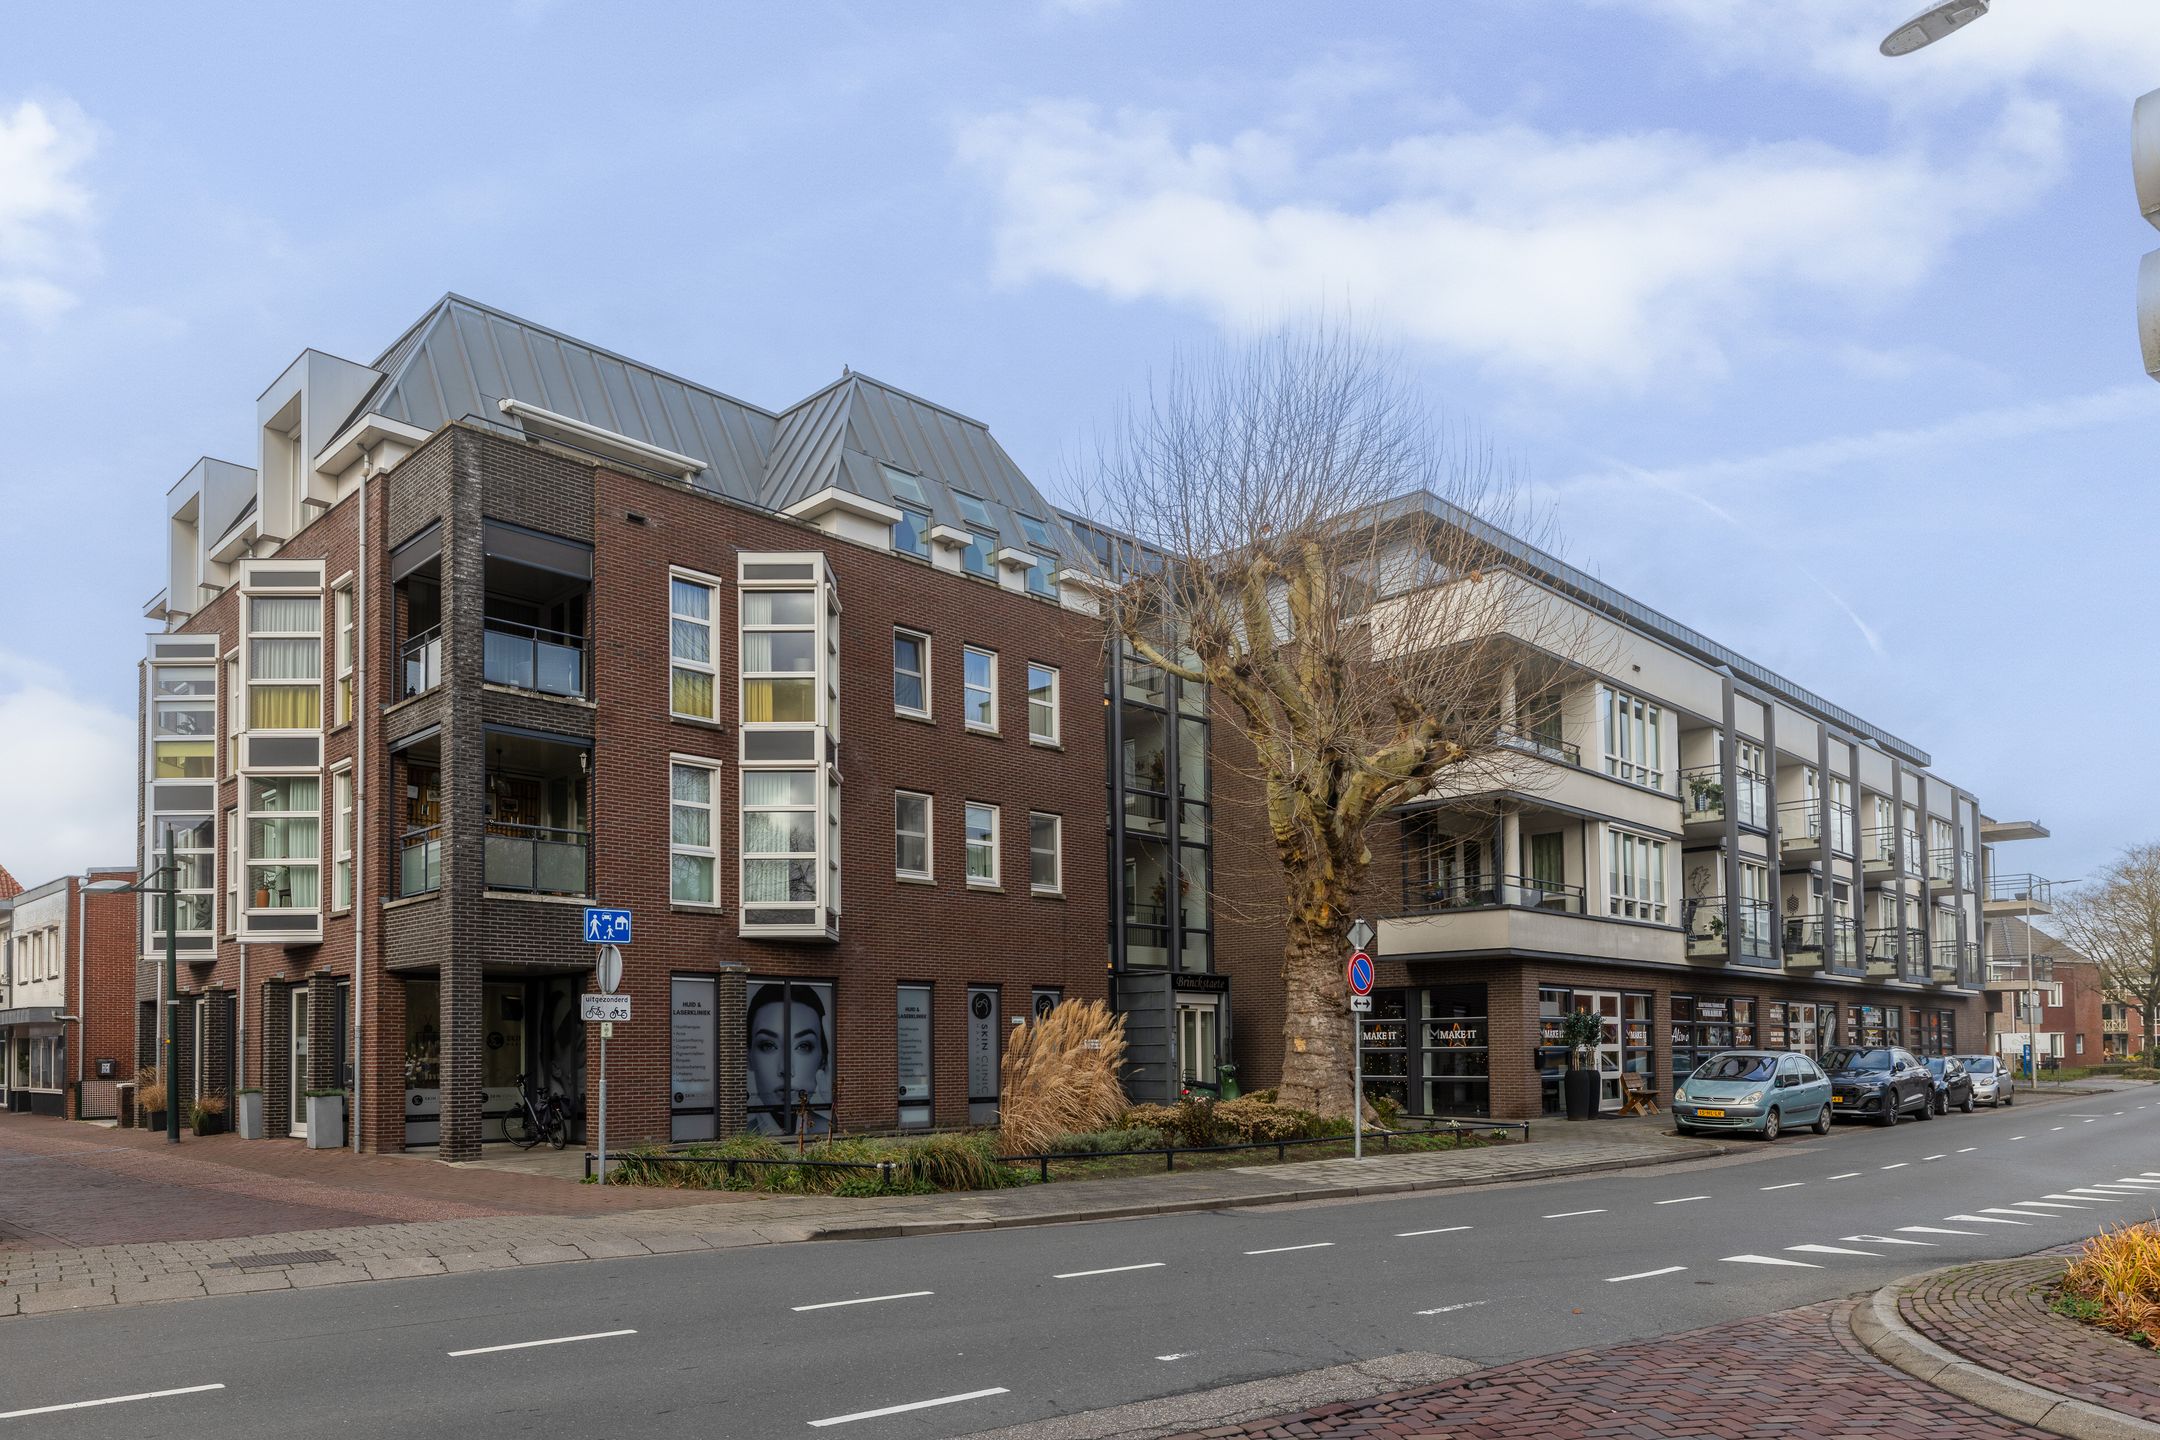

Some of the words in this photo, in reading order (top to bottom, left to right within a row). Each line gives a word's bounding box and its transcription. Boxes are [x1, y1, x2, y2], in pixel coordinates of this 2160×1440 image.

[1363, 1031, 1387, 1040] MAKE
[1387, 1031, 1397, 1040] IT
[1440, 1030, 1466, 1039] MAKE
[1467, 1029, 1477, 1039] IT
[1544, 1030, 1559, 1039] MAKE
[981, 1055, 989, 1096] CLINIC
